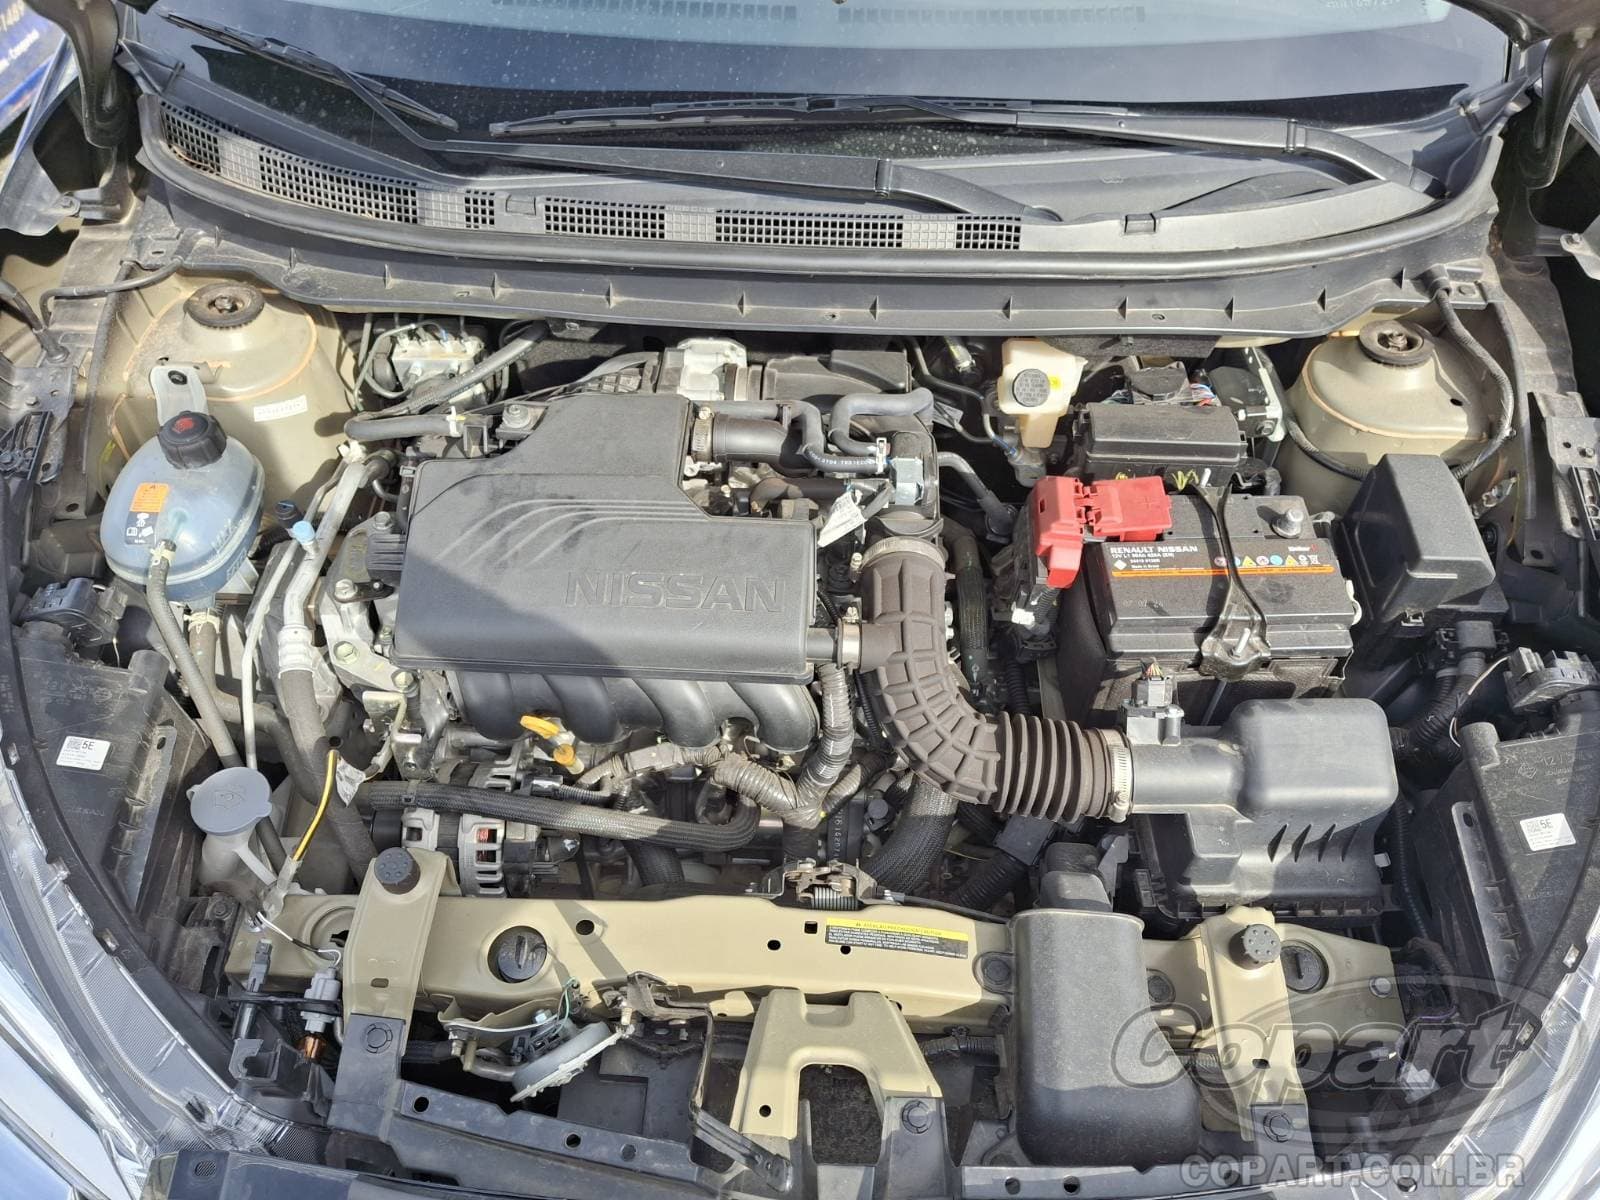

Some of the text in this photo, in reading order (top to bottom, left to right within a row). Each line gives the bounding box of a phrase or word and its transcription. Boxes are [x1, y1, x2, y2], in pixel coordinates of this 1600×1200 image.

[1110, 545, 1198, 554] RENAULT NISSAN
[565, 571, 786, 613] NISSAN
[81, 740, 96, 751] 5E
